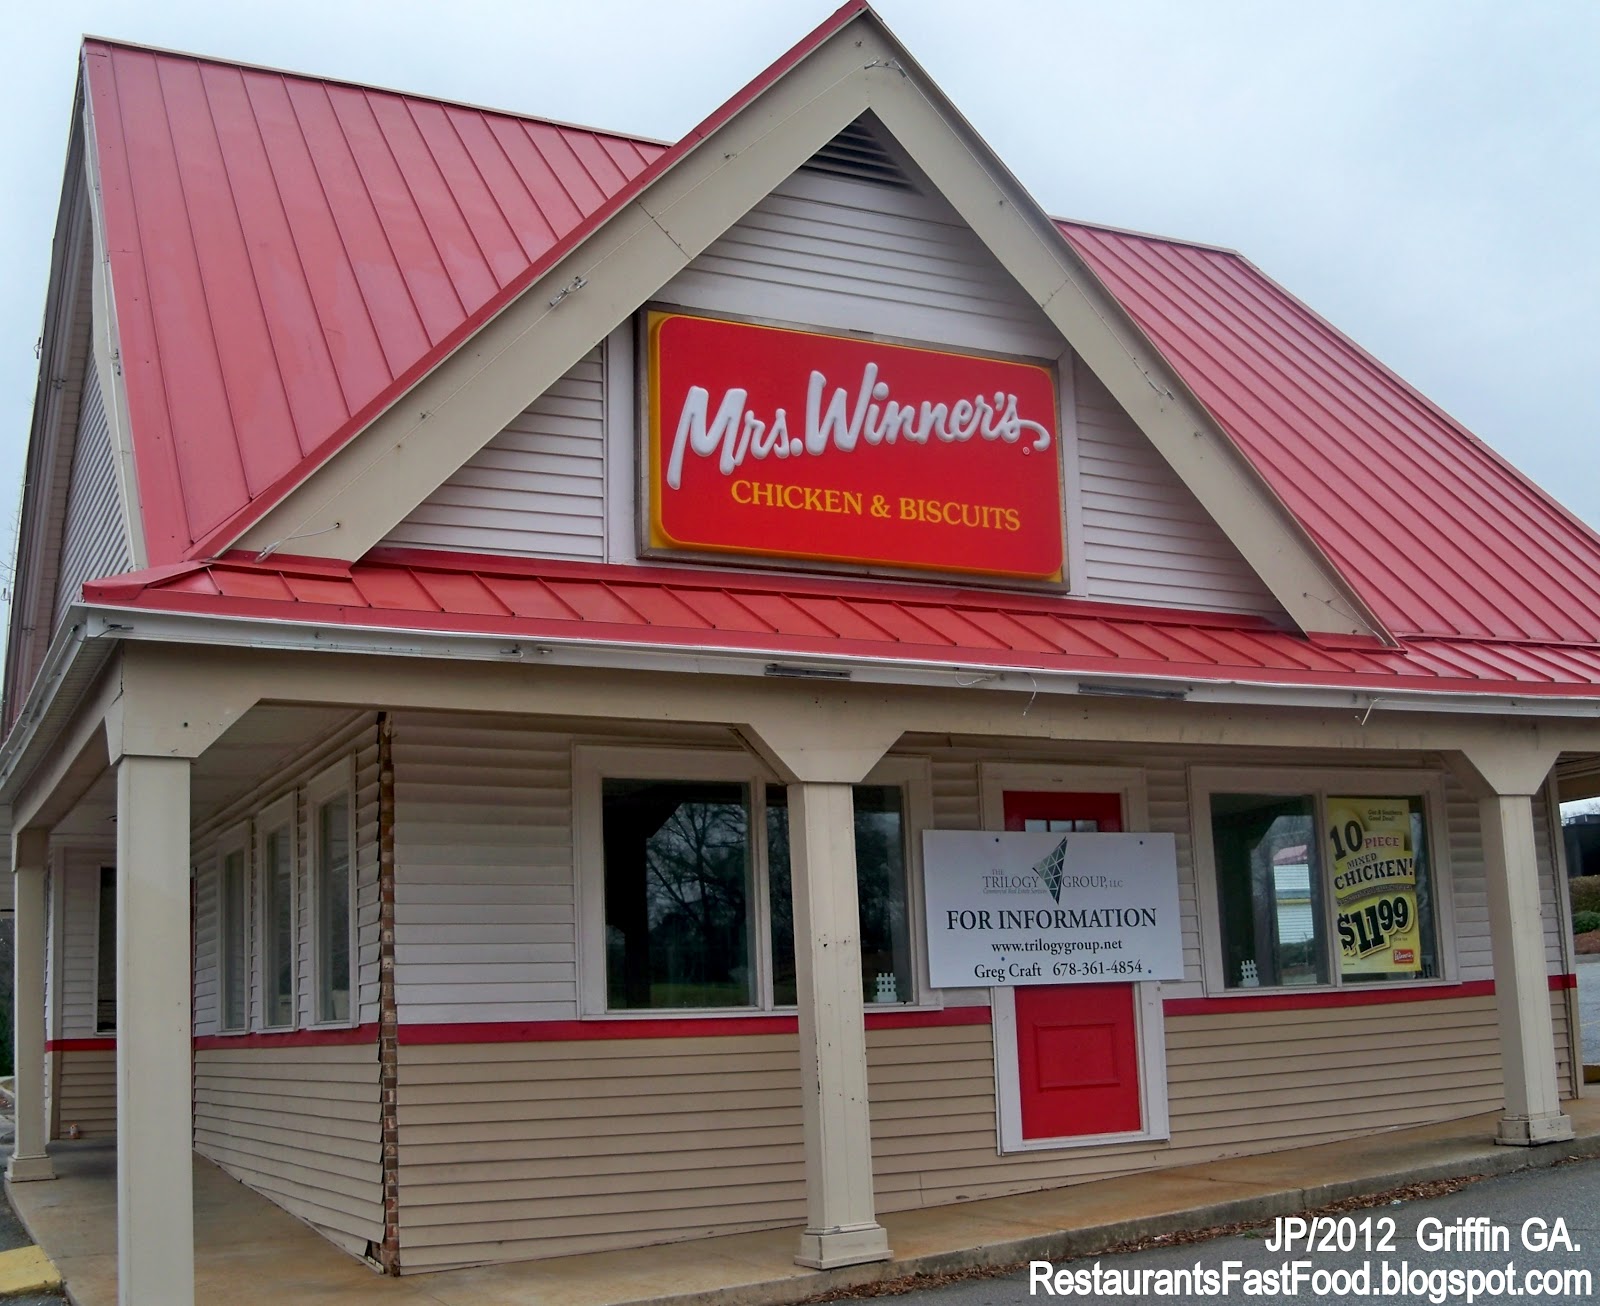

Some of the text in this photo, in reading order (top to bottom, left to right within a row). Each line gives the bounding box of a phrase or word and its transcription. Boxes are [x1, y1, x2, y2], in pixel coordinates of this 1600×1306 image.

[667, 361, 1052, 490] Mrs. Winner's
[731, 480, 1021, 532] CHICKEN & BISCUITS
[1330, 820, 1362, 861] 10
[1364, 836, 1399, 849] PIECE
[1347, 852, 1377, 870] MIXED
[982, 875, 1123, 889] TRILOGY GROUP, LLC
[1334, 857, 1414, 890] CHICKEN!
[947, 908, 1157, 930] FOR INFORMATION
[991, 938, 1122, 955] www.trilogygroup.net
[974, 959, 1143, 982] Greg Craft 678-361-4854
